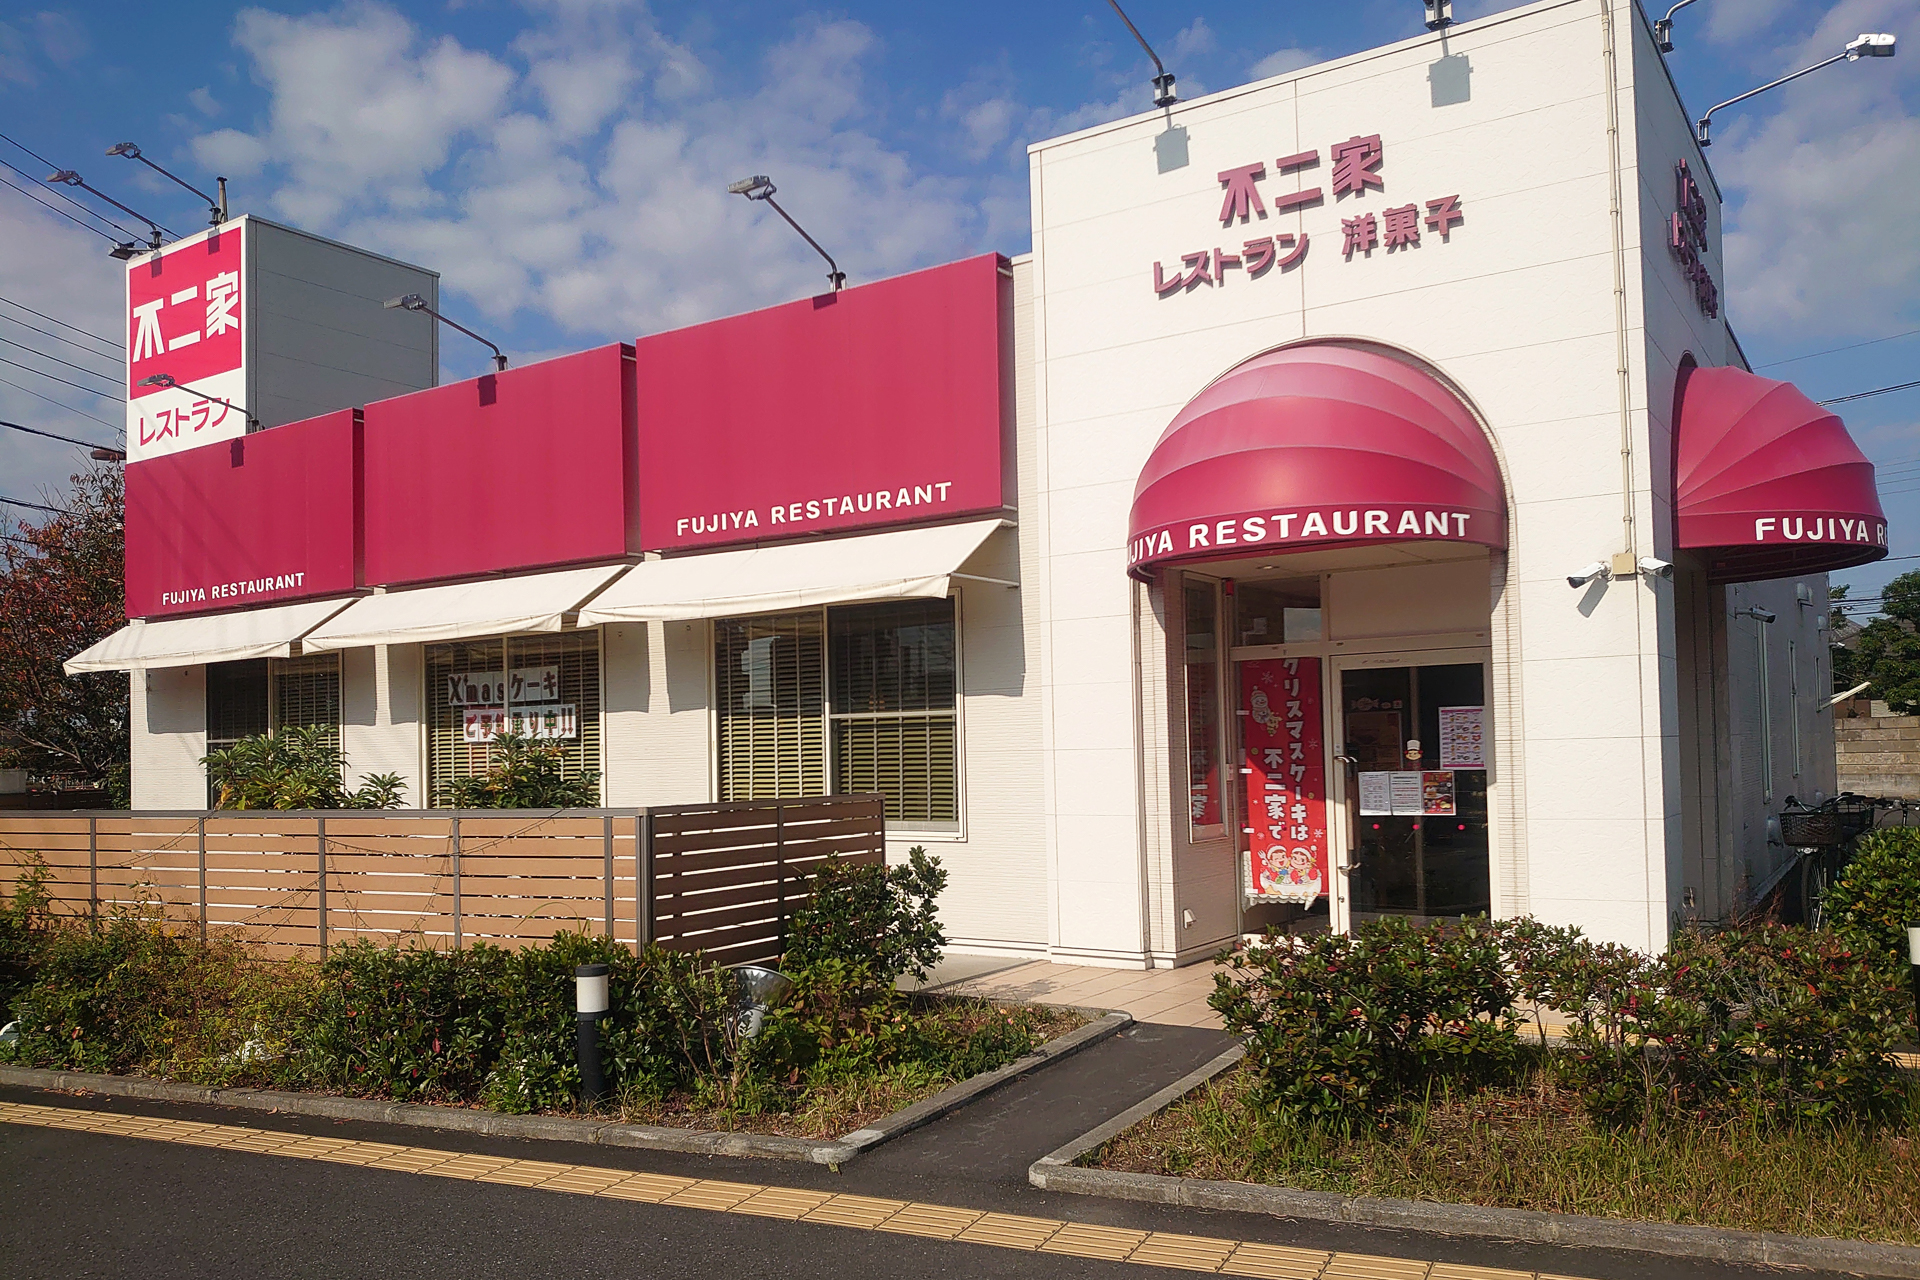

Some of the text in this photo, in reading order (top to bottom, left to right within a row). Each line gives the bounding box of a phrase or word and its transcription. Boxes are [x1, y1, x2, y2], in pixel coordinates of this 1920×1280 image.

[1218, 134, 1383, 221] 不二家
[1153, 195, 1462, 293] レストラン 洋菓子
[132, 271, 239, 363] 不二家
[139, 397, 230, 447] レストラン
[676, 481, 952, 536] FUJIYA RESTAURANT
[1189, 510, 1471, 549] RESTAURANT
[1755, 517, 1869, 542] FUJIYA
[162, 572, 305, 606] FUJIYA RESTAURANT
[1283, 658, 1309, 841] クリスマスケーキは
[1264, 748, 1287, 840] 不二家で
